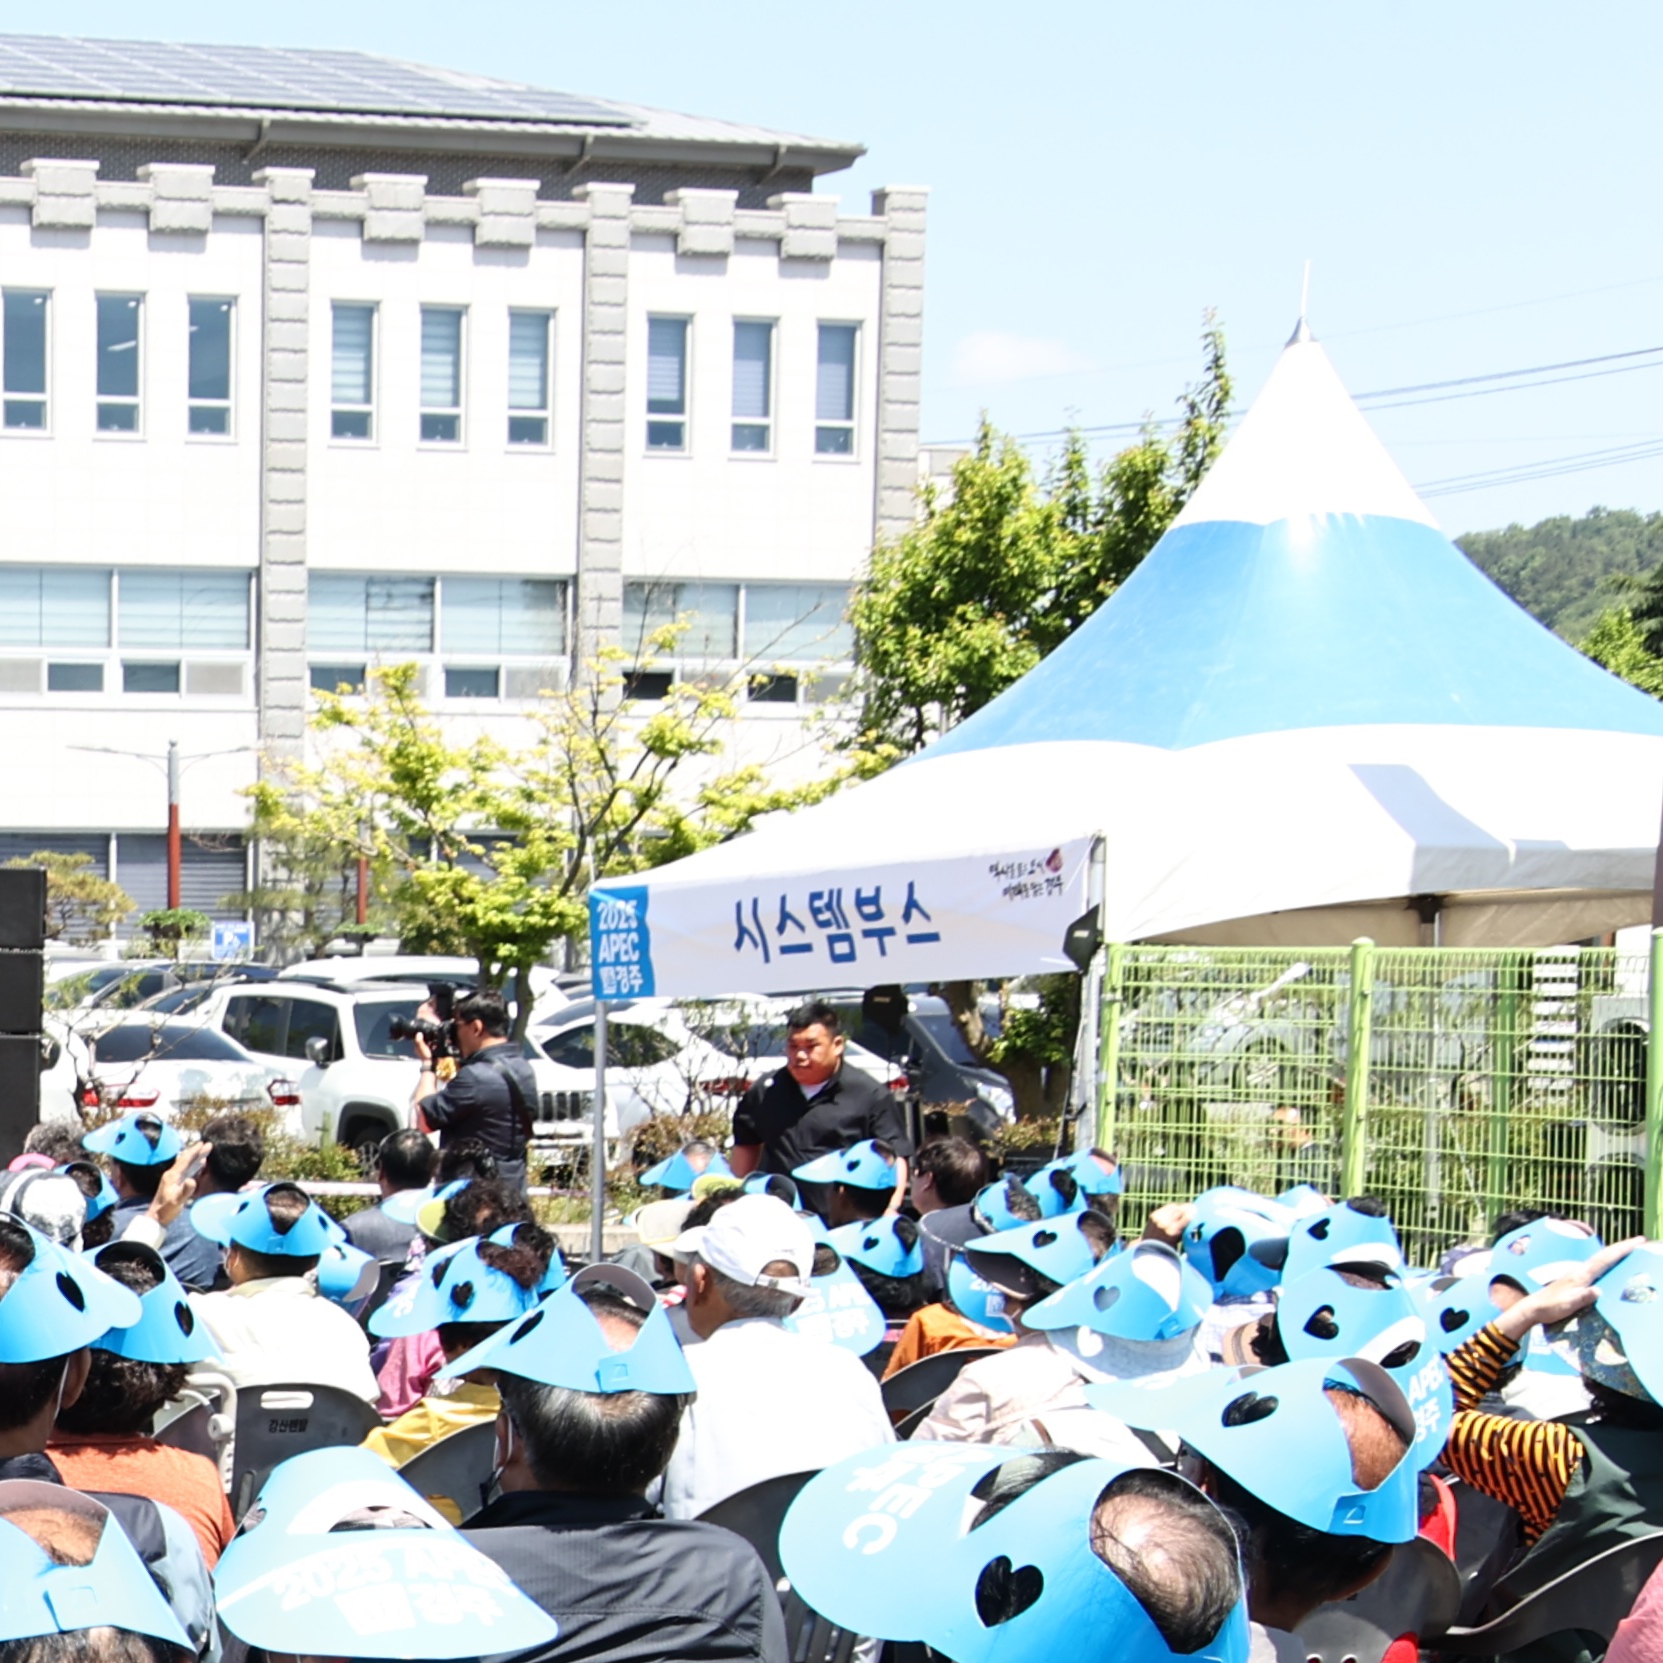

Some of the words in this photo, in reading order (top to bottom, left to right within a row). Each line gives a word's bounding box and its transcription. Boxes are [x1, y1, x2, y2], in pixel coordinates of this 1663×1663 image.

[596, 899, 638, 930] 2025
[733, 880, 941, 964] 시스템부스
[597, 935, 640, 963] APEC
[615, 966, 644, 994] 경주
